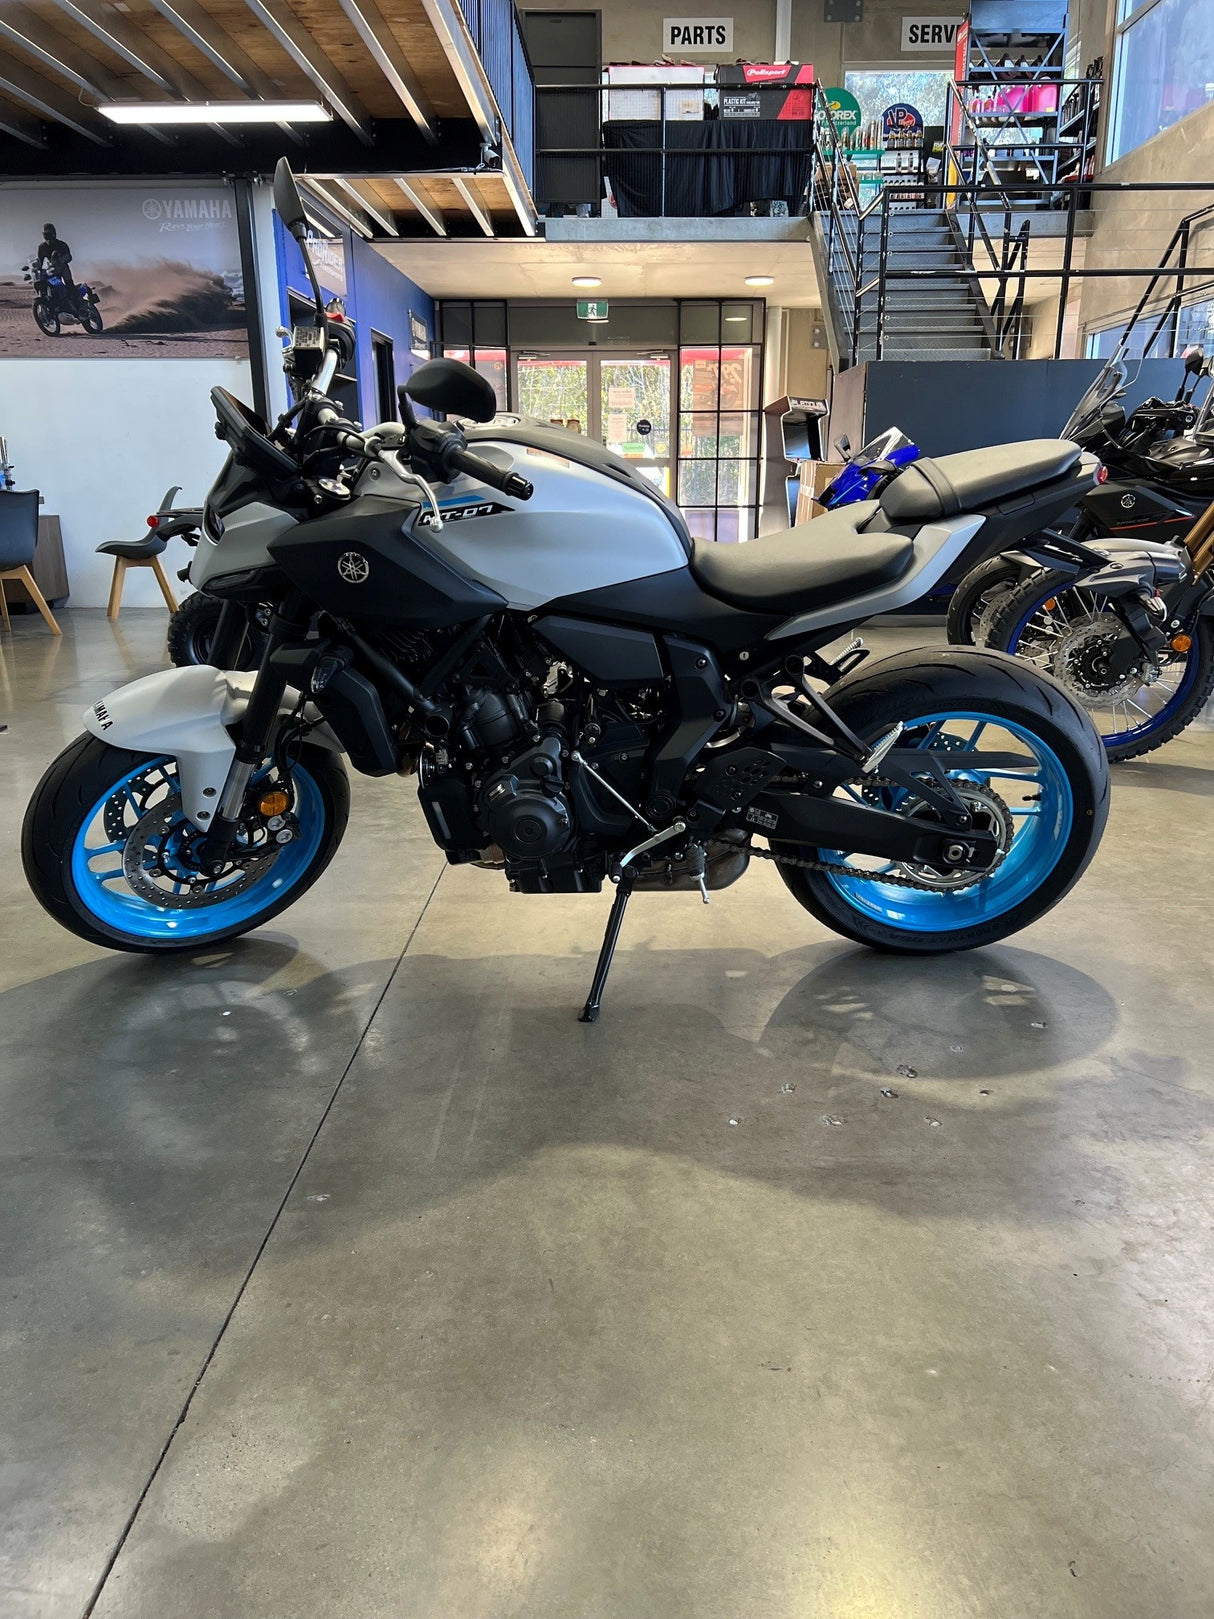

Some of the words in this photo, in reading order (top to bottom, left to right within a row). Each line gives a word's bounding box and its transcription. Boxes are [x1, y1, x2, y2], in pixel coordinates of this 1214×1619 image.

[670, 25, 726, 45] PARTS
[908, 24, 959, 44] SERV
[746, 68, 786, 77] Polisport
[814, 109, 857, 120] OOREX
[161, 199, 233, 219] YAMAHA
